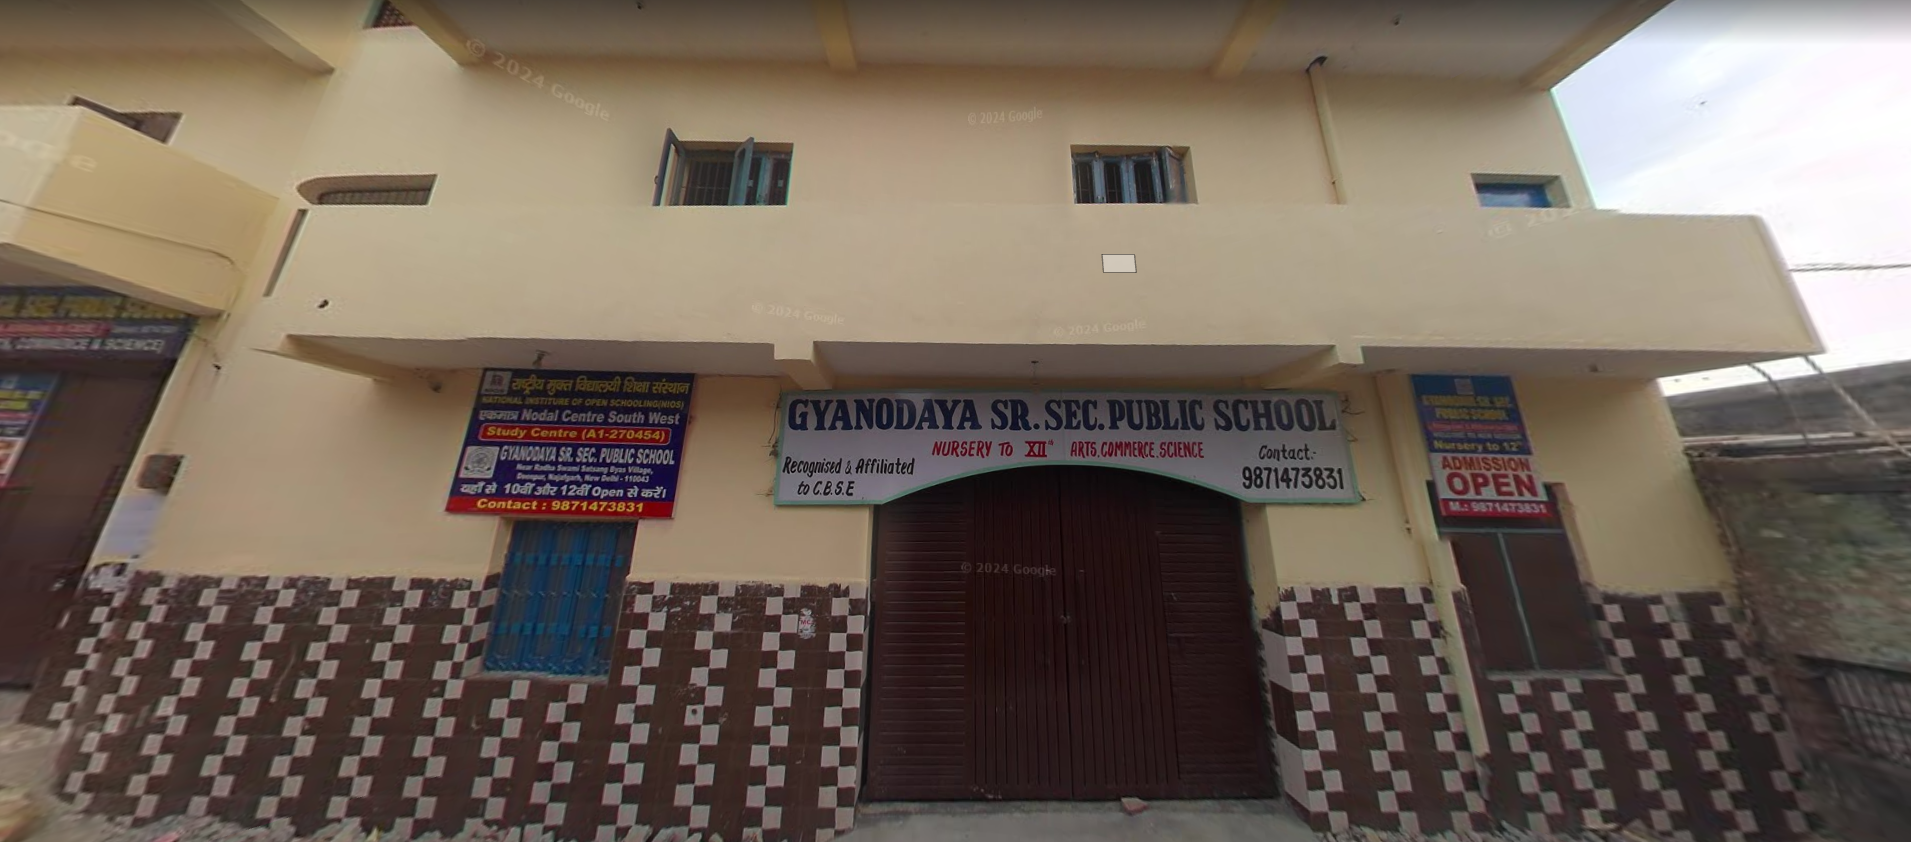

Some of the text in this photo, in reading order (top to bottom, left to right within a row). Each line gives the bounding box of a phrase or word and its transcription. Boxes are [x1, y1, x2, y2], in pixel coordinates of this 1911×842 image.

[511, 374, 691, 396] राष्ट्रीय मुक्त विद्यालयी शिक्षा संस्थान
[481, 396, 523, 405] NATIONAL
[571, 398, 583, 406] OF
[584, 398, 609, 407] OPEN
[520, 408, 559, 421] Nodal
[562, 409, 605, 423] Centre
[607, 410, 646, 424] South
[648, 411, 681, 425] West
[788, 398, 983, 431] GYANODAYA
[990, 399, 1040, 431] SR.
[1108, 399, 1205, 431] PUBLIC
[1213, 398, 1337, 432] SCHOOL
[487, 426, 666, 442] Study Centre (A1-270454)
[500, 445, 675, 464] GYANODAYA SR. SEC. PUBLIC SCHOOL
[932, 440, 993, 458] NURSERY
[998, 441, 1014, 457] TO
[1433, 440, 1483, 452] Nursery
[1486, 442, 1499, 451] to
[782, 456, 916, 477] Recognised & Affiliated
[1441, 456, 1532, 472] ADMISSION
[1241, 465, 1345, 490] 9871473831
[1446, 472, 1538, 497] OPEN
[485, 482, 498, 495] से
[534, 483, 558, 496] और
[592, 486, 624, 499] Open
[627, 486, 640, 498] से
[797, 480, 811, 496] to
[477, 498, 538, 510] Contact
[551, 500, 644, 512] 9871473831
[1472, 502, 1547, 513] 9871473831
